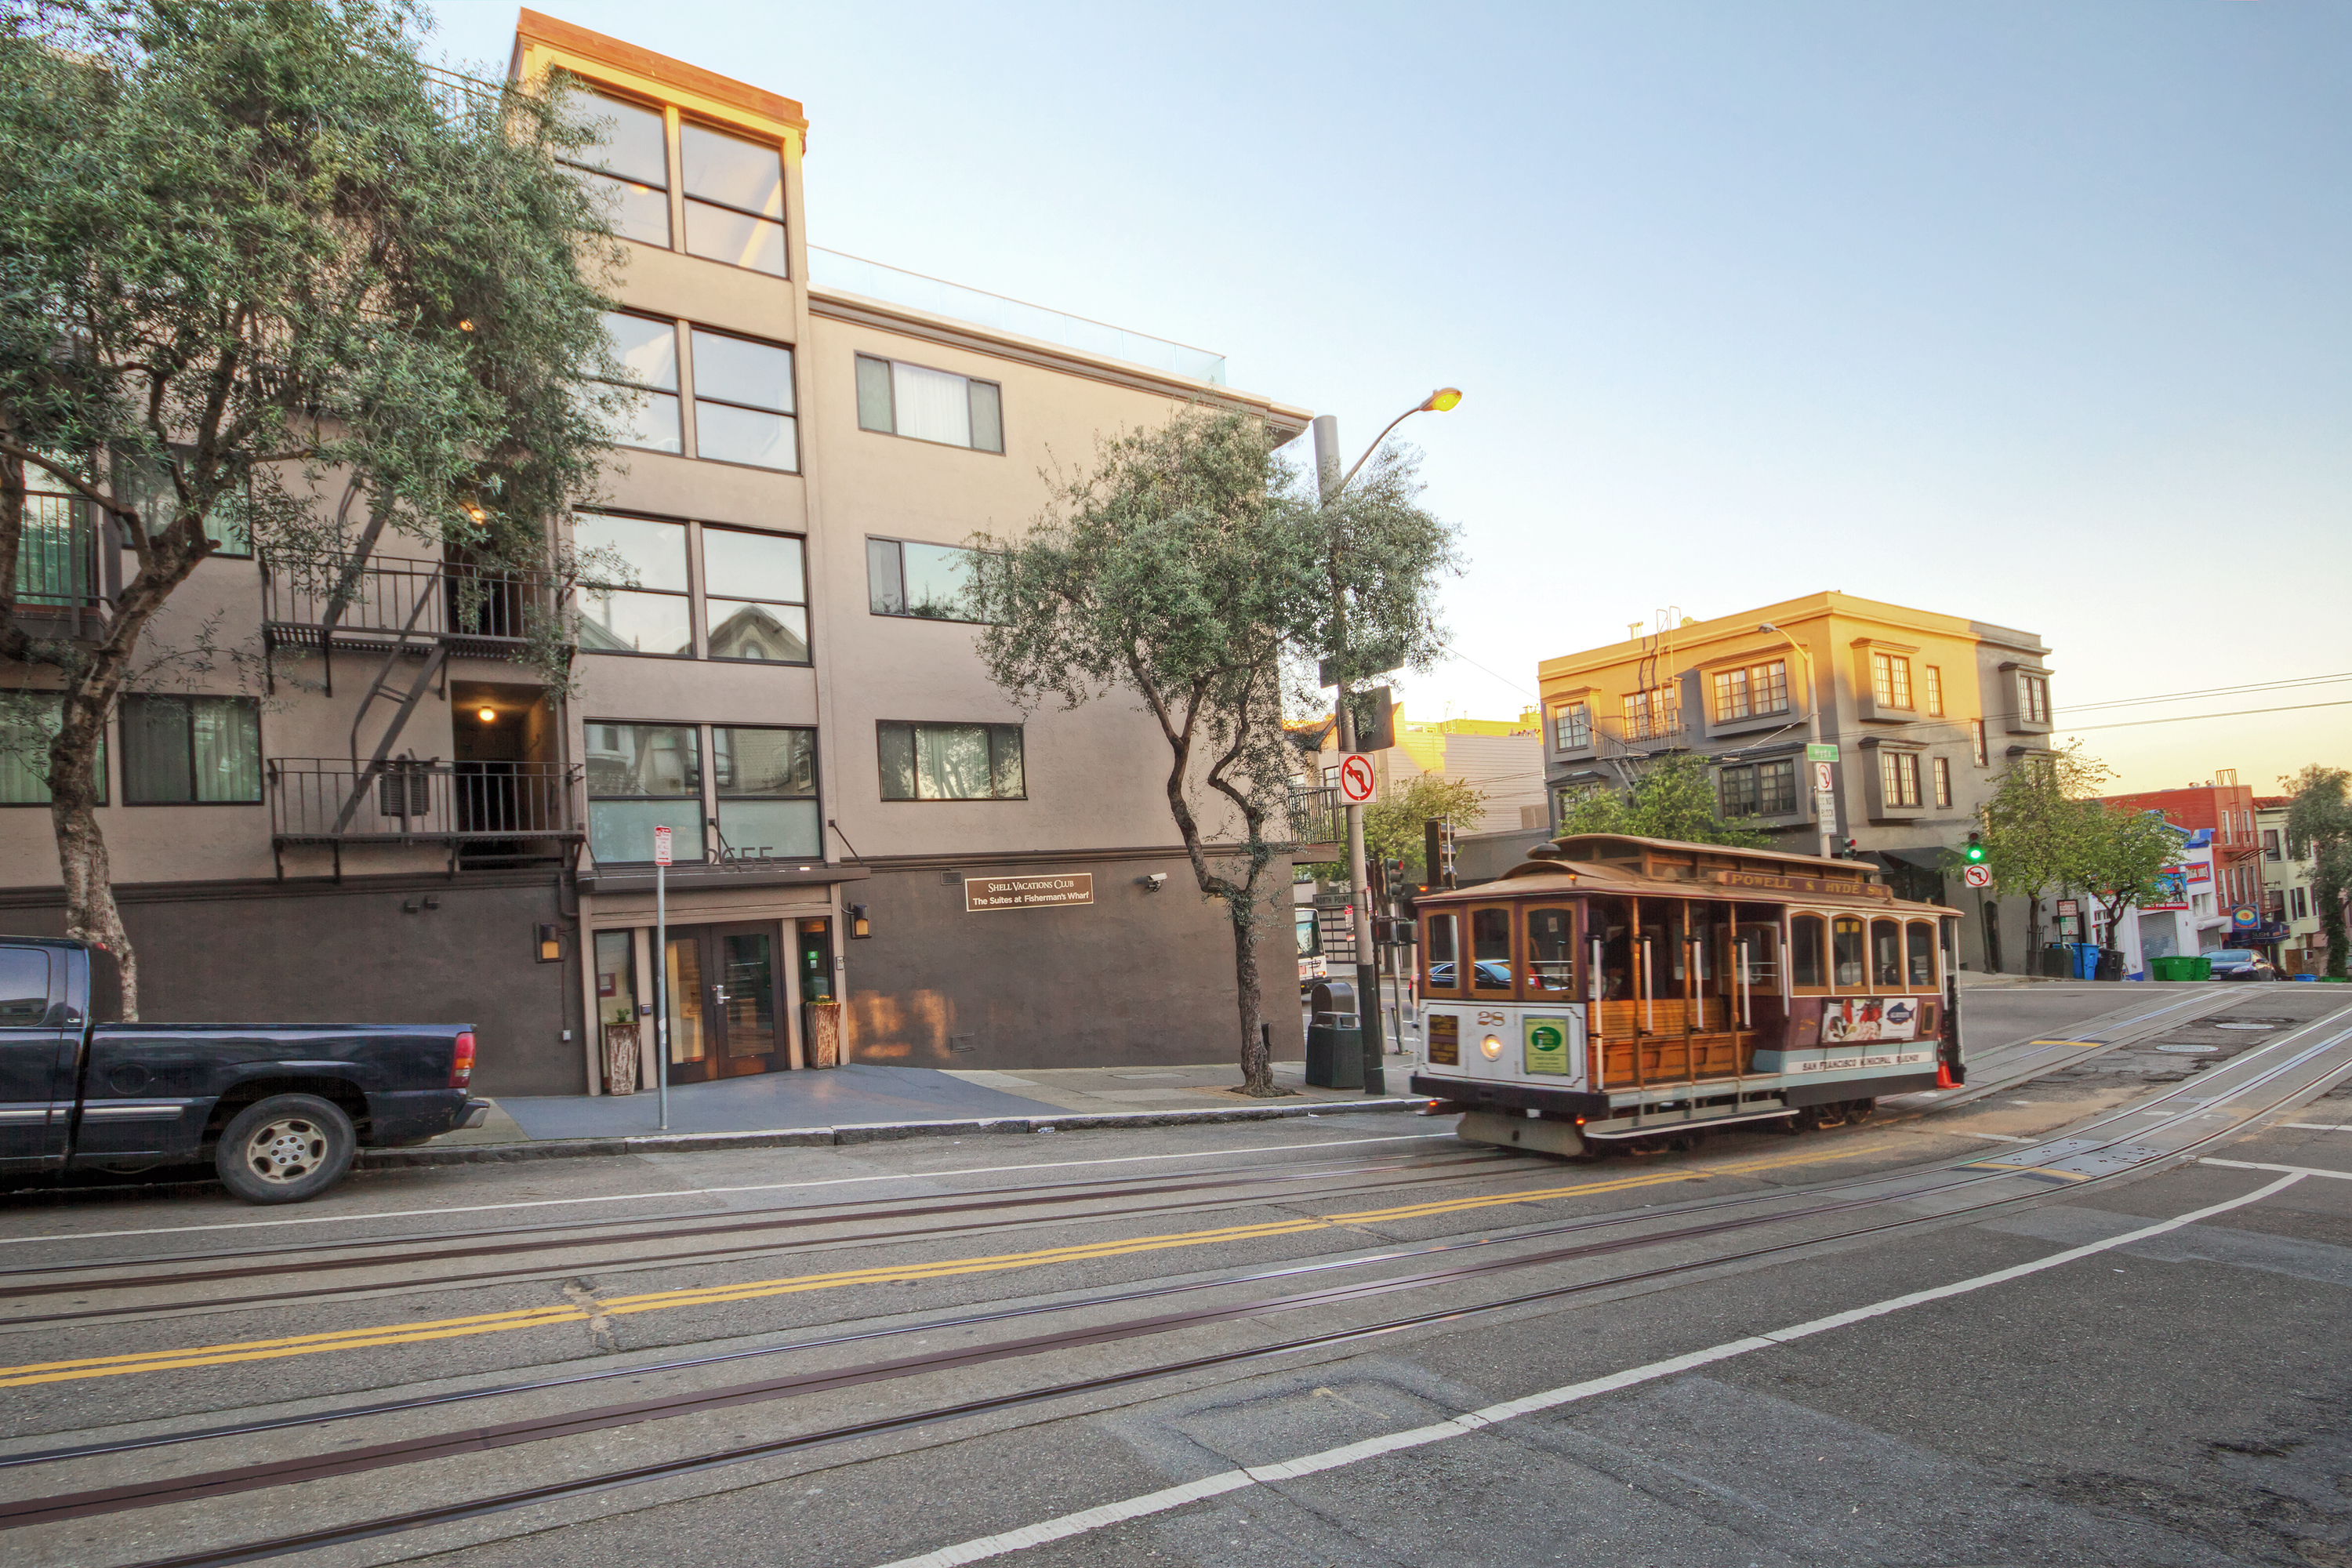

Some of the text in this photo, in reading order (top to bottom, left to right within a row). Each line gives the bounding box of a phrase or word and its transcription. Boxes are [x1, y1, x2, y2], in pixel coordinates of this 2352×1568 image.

[703, 847, 774, 873] 2655
[1731, 874, 1793, 888] POWELL
[1806, 880, 1814, 891] &
[1825, 882, 1860, 894] HYDE
[989, 896, 1013, 905] Suites
[1024, 893, 1066, 902] Fisherman's
[1067, 891, 1090, 900] Wharf
[1316, 895, 1349, 905] NORTH POINT
[1477, 1011, 1505, 1027] 28
[1802, 1062, 1818, 1071] SAN
[1820, 1059, 1857, 1070] FRANCISCO
